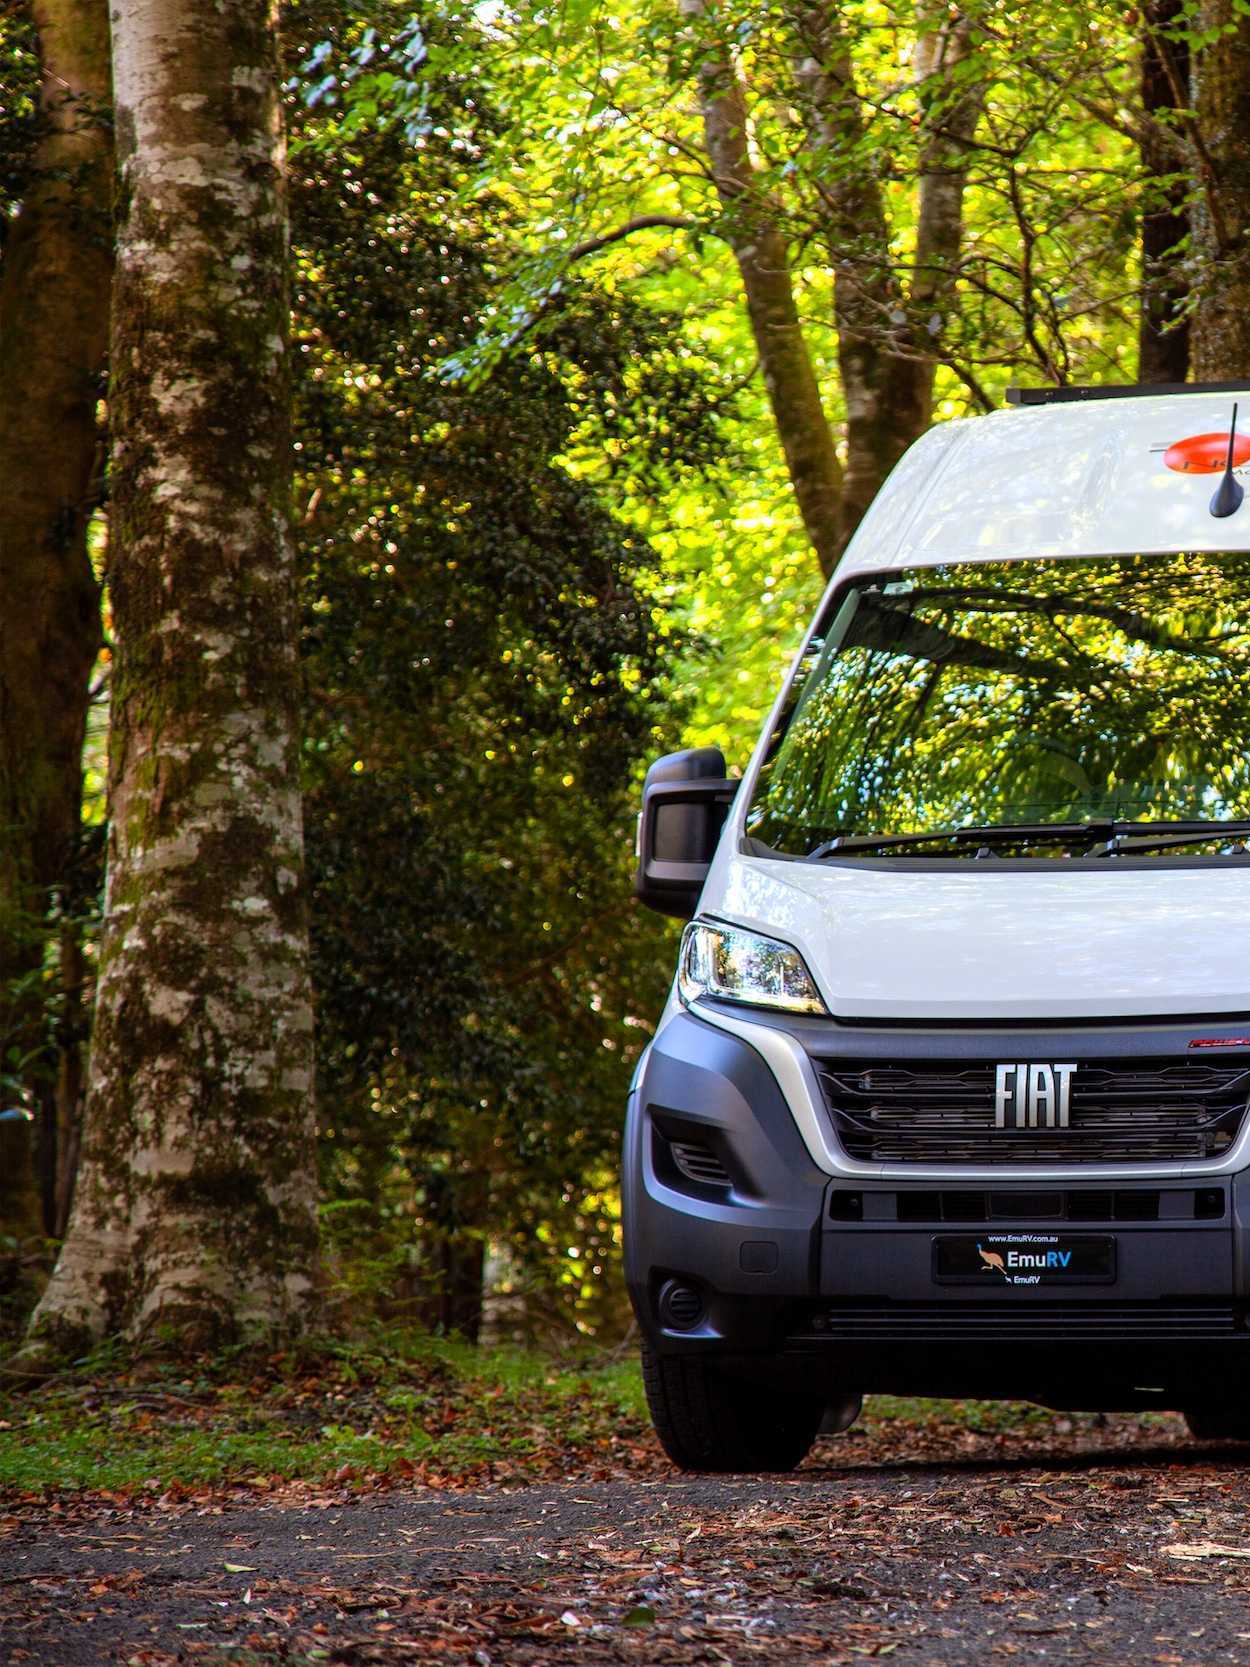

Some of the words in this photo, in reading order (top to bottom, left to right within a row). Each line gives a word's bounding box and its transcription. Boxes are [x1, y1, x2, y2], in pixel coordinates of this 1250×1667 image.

[995, 1064, 1077, 1128] FIAT
[987, 1234, 1059, 1243] www.EmuRV.com.au
[1007, 1251, 1072, 1268] EmuRV
[1013, 1275, 1041, 1284] EmuRV
